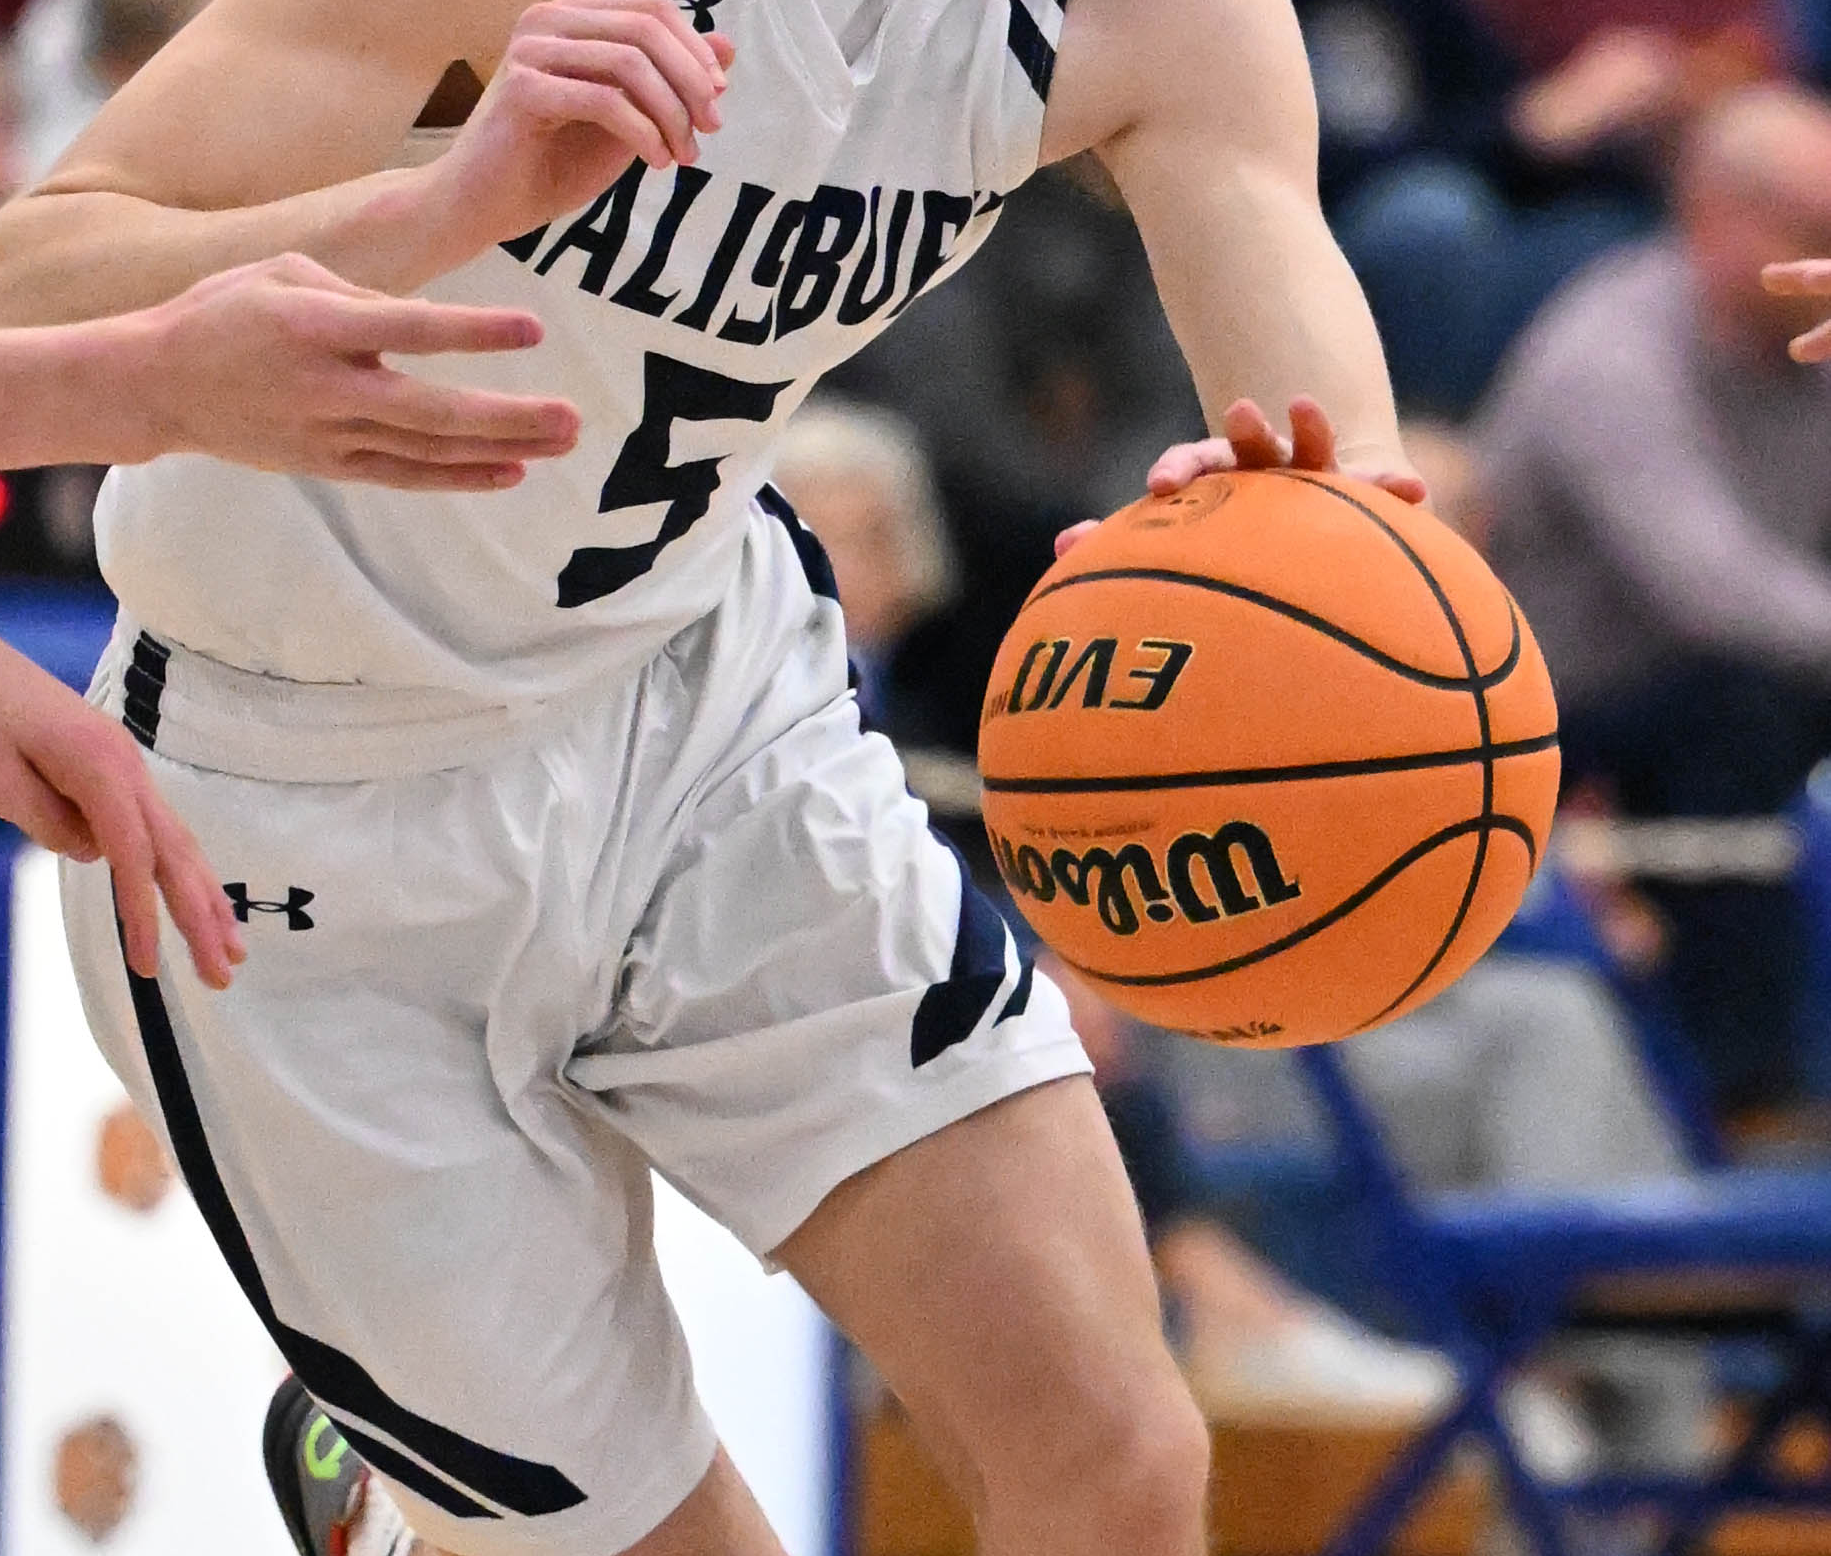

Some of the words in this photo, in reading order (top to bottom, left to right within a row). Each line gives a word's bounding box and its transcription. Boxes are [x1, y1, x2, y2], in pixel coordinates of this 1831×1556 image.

[498, 155, 1004, 345] ALISBUR
[556, 351, 796, 608] 5
[1006, 637, 1195, 714] EVO
[984, 820, 1302, 936] Wilson
